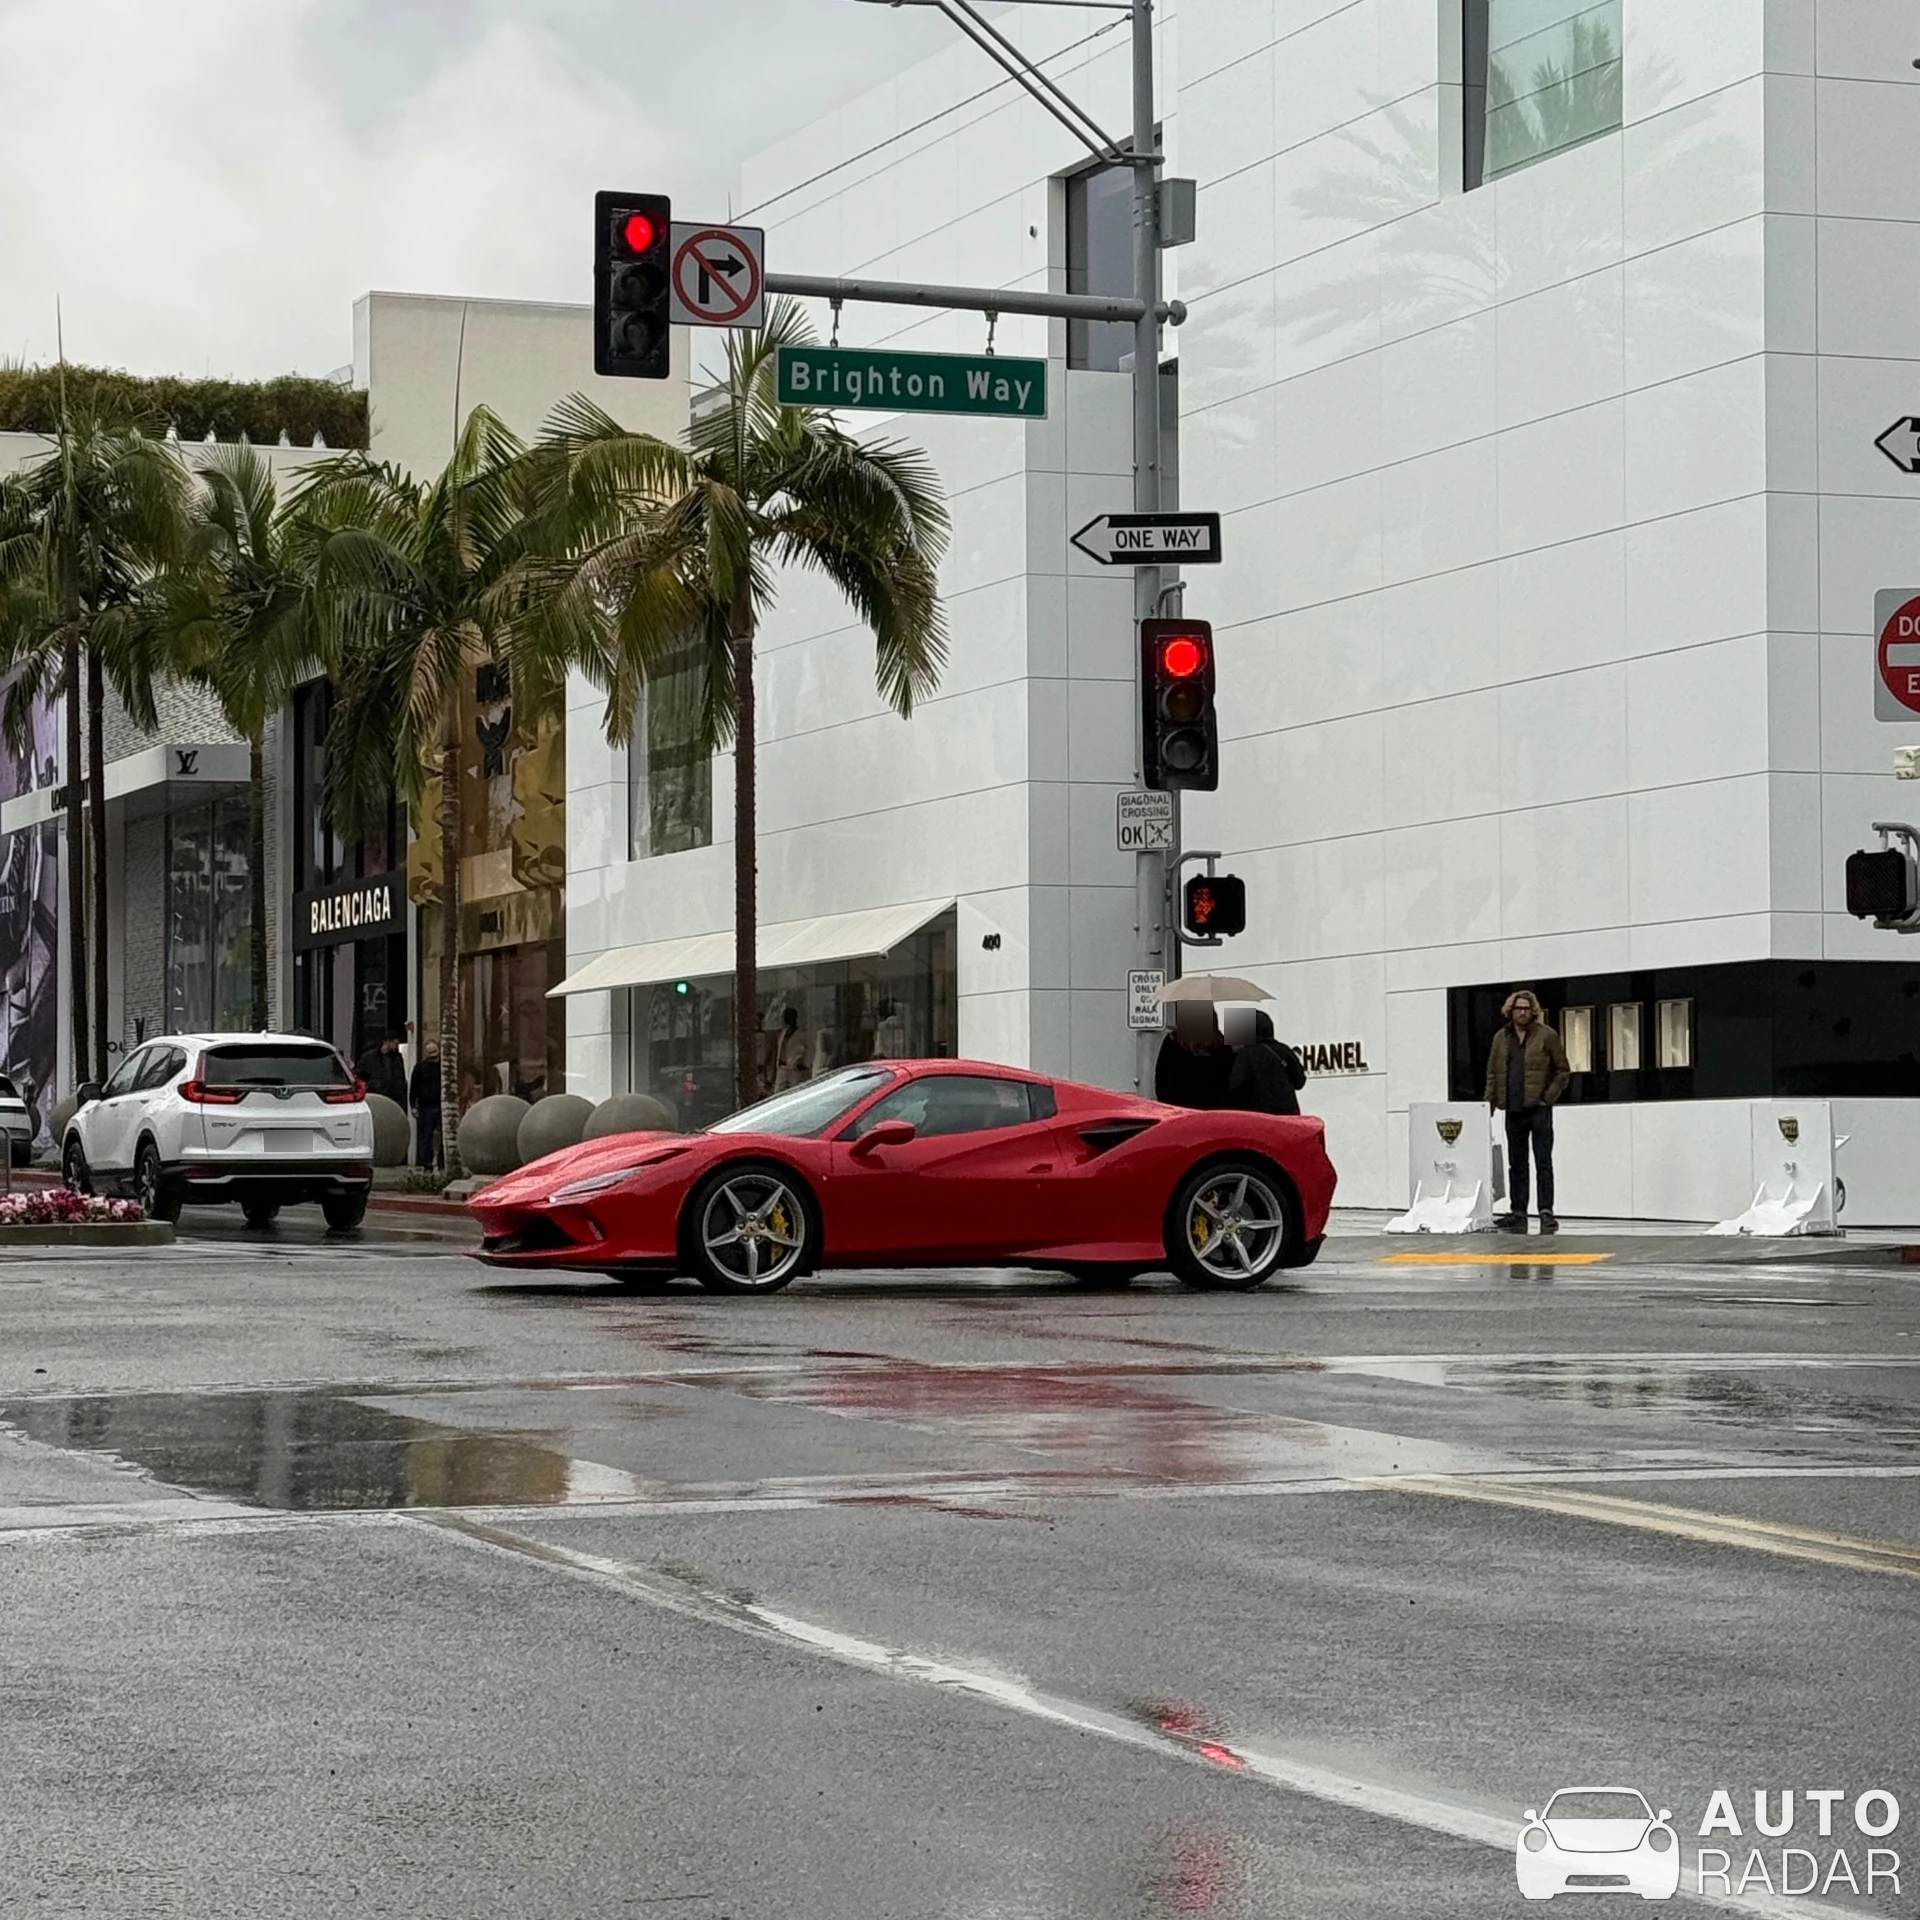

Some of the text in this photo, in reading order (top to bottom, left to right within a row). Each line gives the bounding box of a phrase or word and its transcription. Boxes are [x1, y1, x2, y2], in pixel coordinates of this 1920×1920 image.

[791, 361, 1032, 410] Brighton Way
[1115, 528, 1201, 549] ONE WAY
[1121, 794, 1170, 806] DIAGONAL
[1122, 806, 1169, 818] CROSSING
[1122, 826, 1143, 845] OK
[311, 886, 391, 934] BALENCIAGA
[1132, 974, 1161, 984] CROSS
[1135, 984, 1157, 994] ONLY
